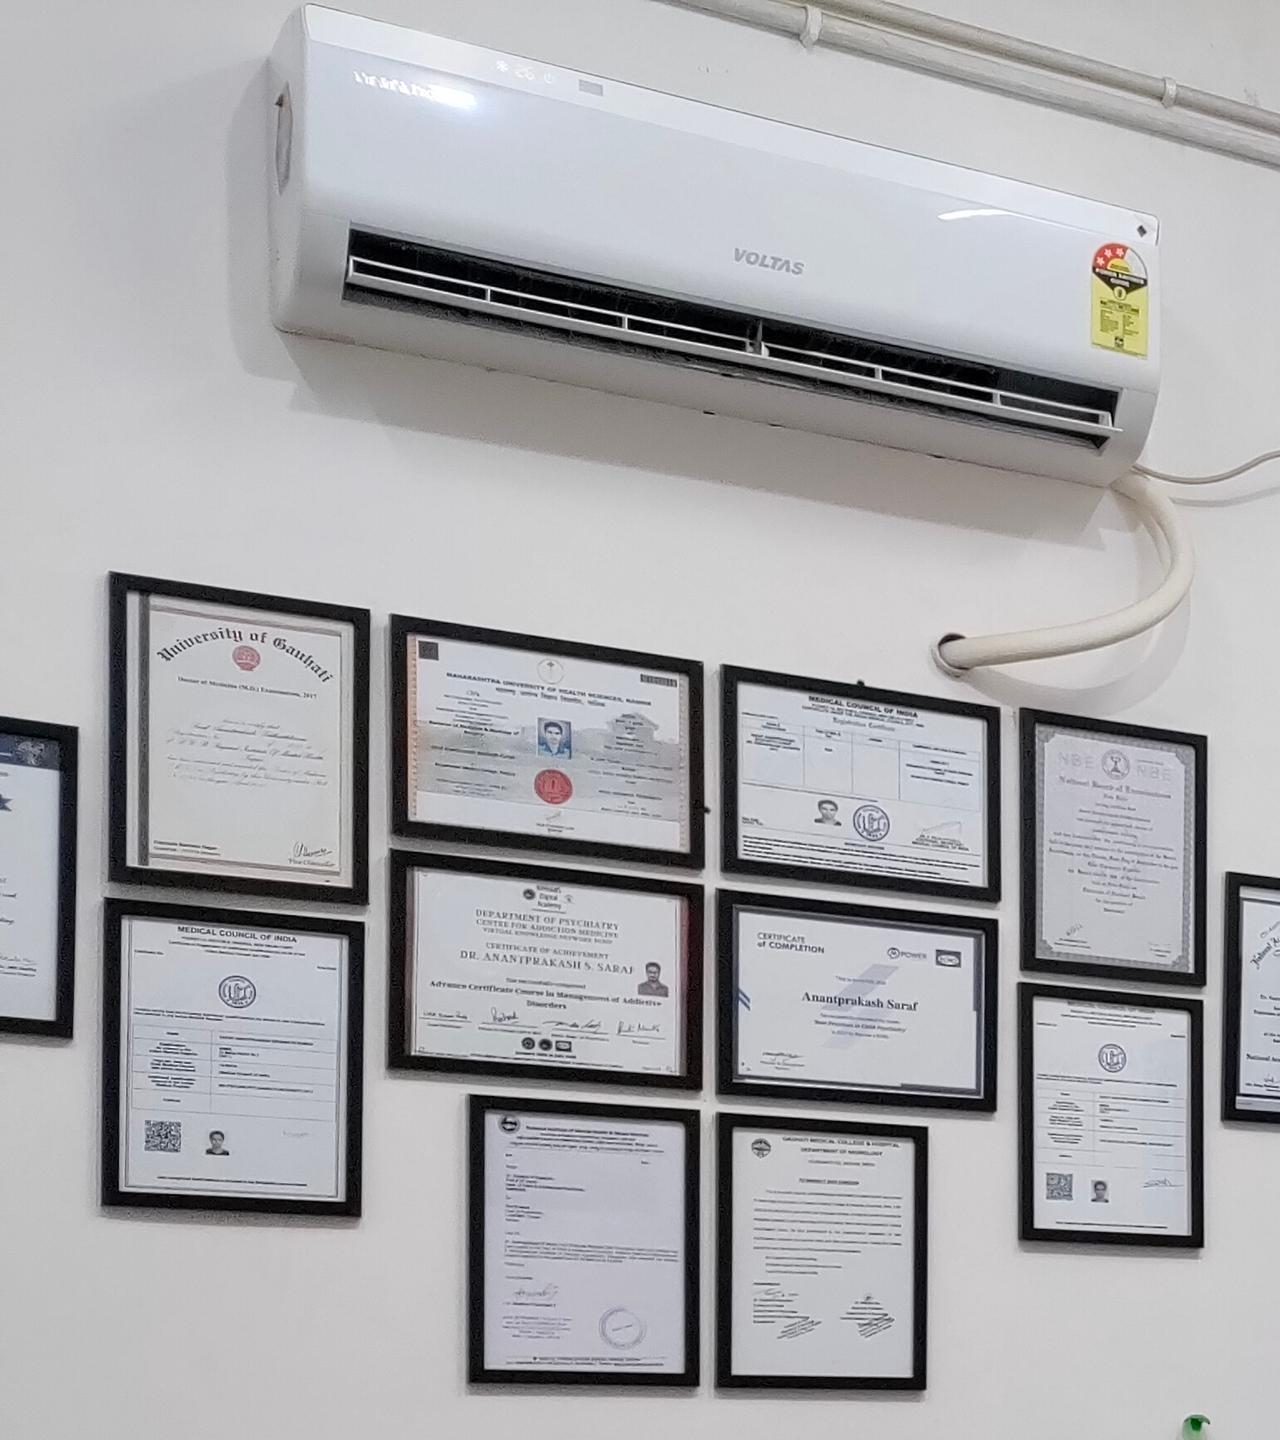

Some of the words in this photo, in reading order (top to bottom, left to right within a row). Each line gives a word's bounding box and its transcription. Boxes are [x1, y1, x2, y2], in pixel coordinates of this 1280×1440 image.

[733, 248, 805, 275] VOLTAS
[156, 627, 243, 662] University
[249, 631, 269, 645] of
[272, 636, 334, 683] Gauhati
[503, 679, 544, 692] UNIVERSITY
[558, 686, 587, 698] HEALTH
[808, 694, 845, 710] MEDICAL
[846, 701, 882, 715] COUNCIL
[884, 707, 894, 716] OF
[895, 708, 919, 720] INDIA
[475, 909, 541, 923] DEPARTMENT
[543, 916, 556, 925] OF
[558, 917, 619, 932] PSYCHIATRY
[510, 921, 528, 931] FOR
[529, 923, 577, 936] ADDICTION
[177, 925, 217, 937] MEDICAL
[219, 929, 257, 940] COUNCIL
[260, 933, 272, 942] OF
[273, 934, 298, 945] INDIA
[757, 931, 806, 944] CERTIFICATE
[486, 942, 538, 955] CERTIFICATE
[539, 945, 550, 955] OF
[552, 947, 609, 961] ACHIEVEMENT
[757, 940, 767, 949] of
[768, 941, 825, 955] COMPLETION
[459, 950, 479, 962] DR.
[483, 951, 582, 971] ANANTPRAKASH
[802, 991, 884, 1010] Anantprakash
[886, 998, 919, 1012] Saraf
